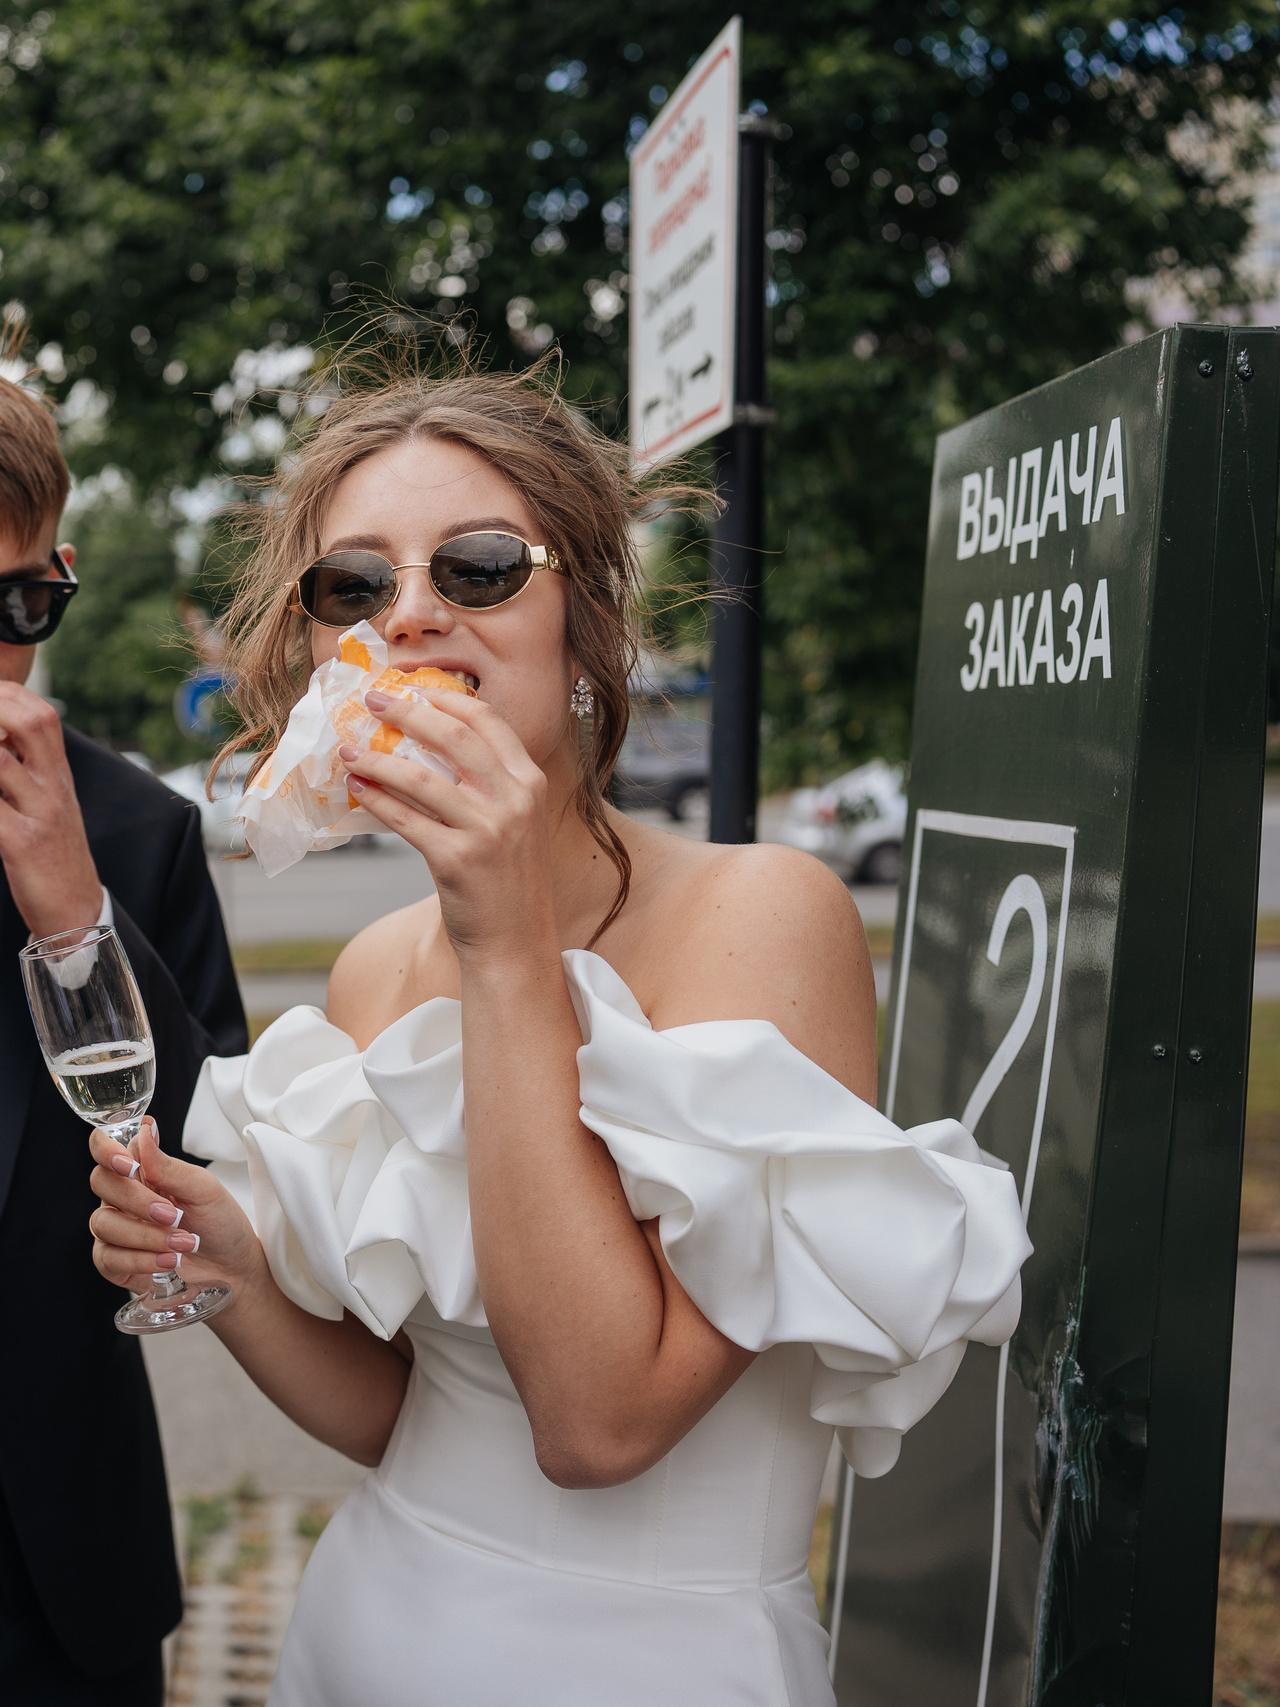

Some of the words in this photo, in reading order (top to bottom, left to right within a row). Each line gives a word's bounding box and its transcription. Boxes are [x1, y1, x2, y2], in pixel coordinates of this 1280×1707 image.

[957, 416, 1125, 565] ВЫДАЧА
[960, 578, 1112, 692] ЗАКАЗА
[961, 873, 1048, 1170] 2
